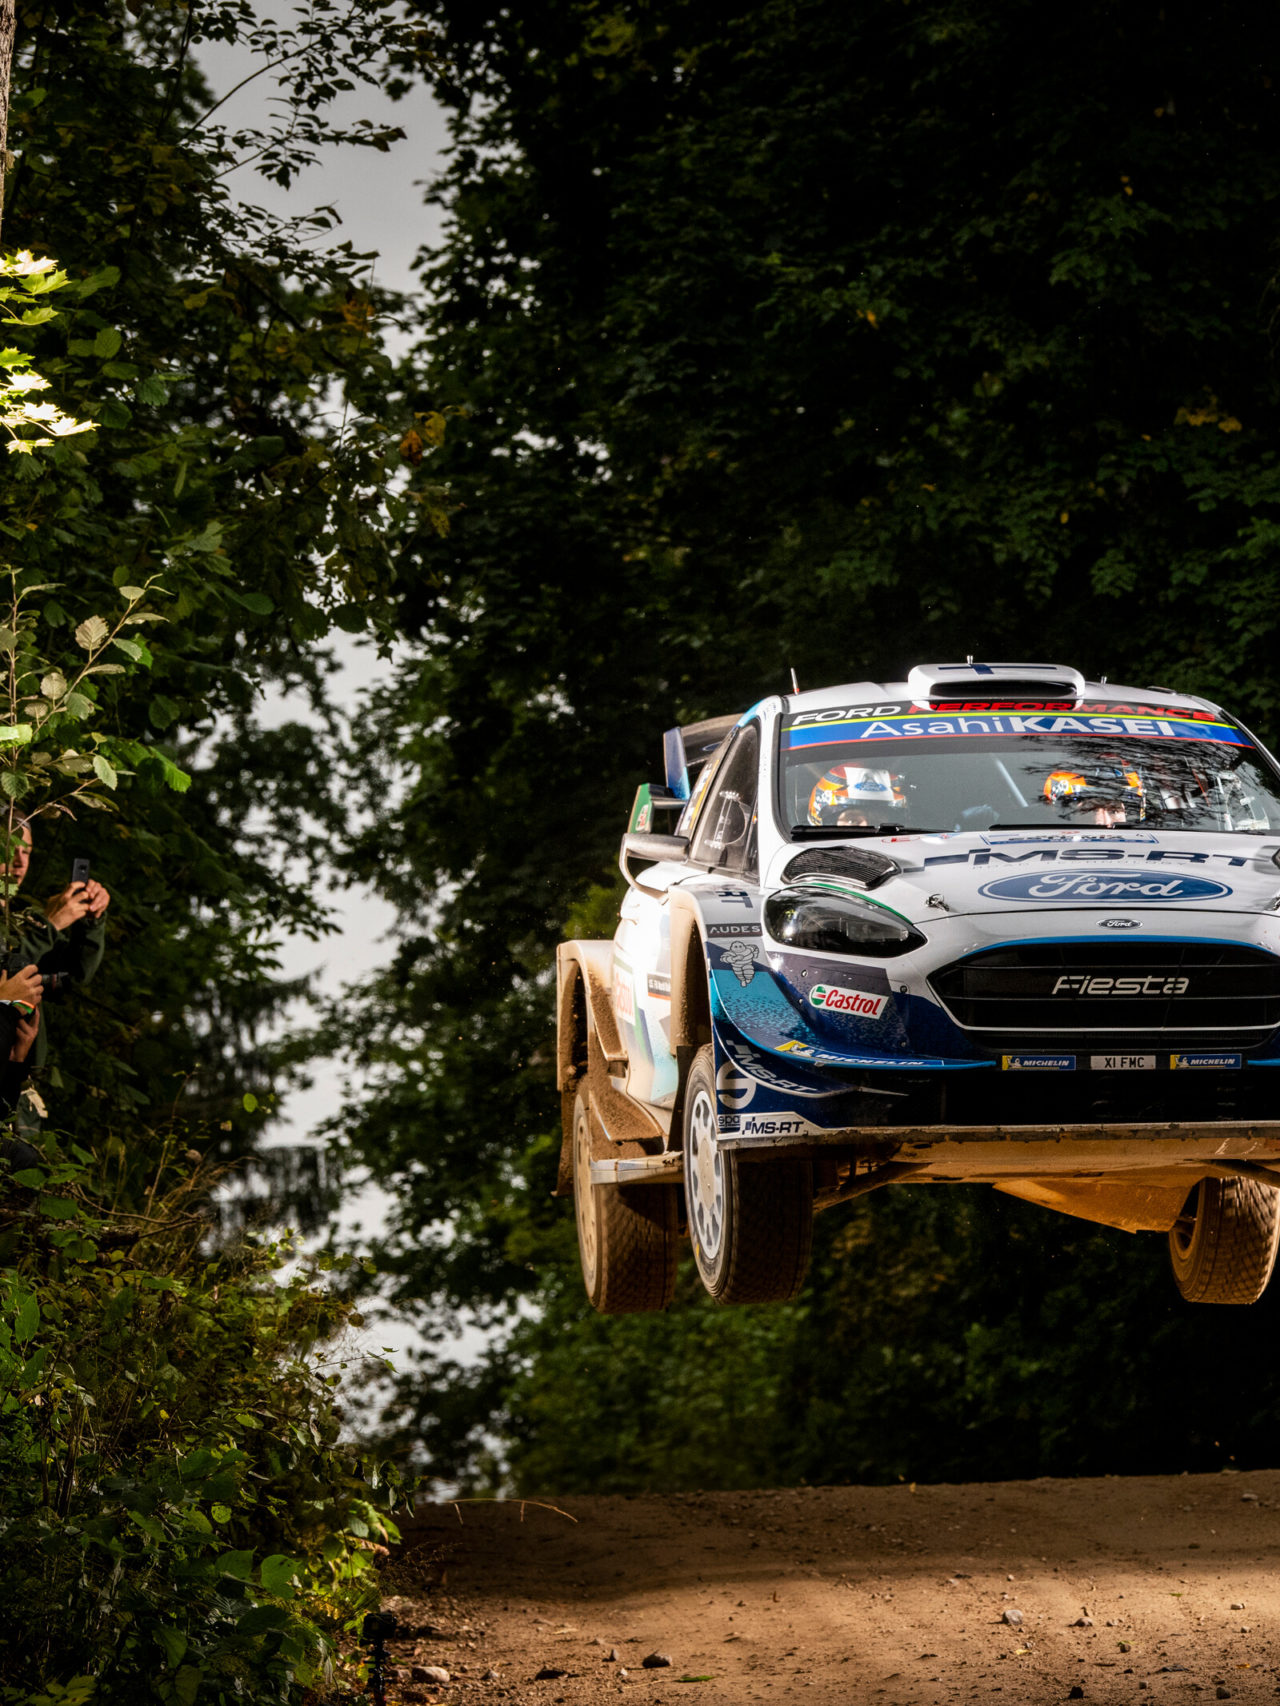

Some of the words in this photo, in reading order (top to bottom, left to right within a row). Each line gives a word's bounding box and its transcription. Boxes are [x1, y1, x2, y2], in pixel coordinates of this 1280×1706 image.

[792, 706, 902, 726] FORD
[1028, 872, 1184, 898] Ford
[709, 924, 761, 934] AUDES
[1051, 975, 1190, 995] Fiesta
[825, 989, 882, 1016] Castrol
[816, 1053, 925, 1066] MICHELIN
[1022, 1059, 1070, 1067] MICHELIN
[1120, 1057, 1145, 1068] FMC
[1190, 1057, 1236, 1065] MICHELIN
[750, 1121, 804, 1134] MS-RT
